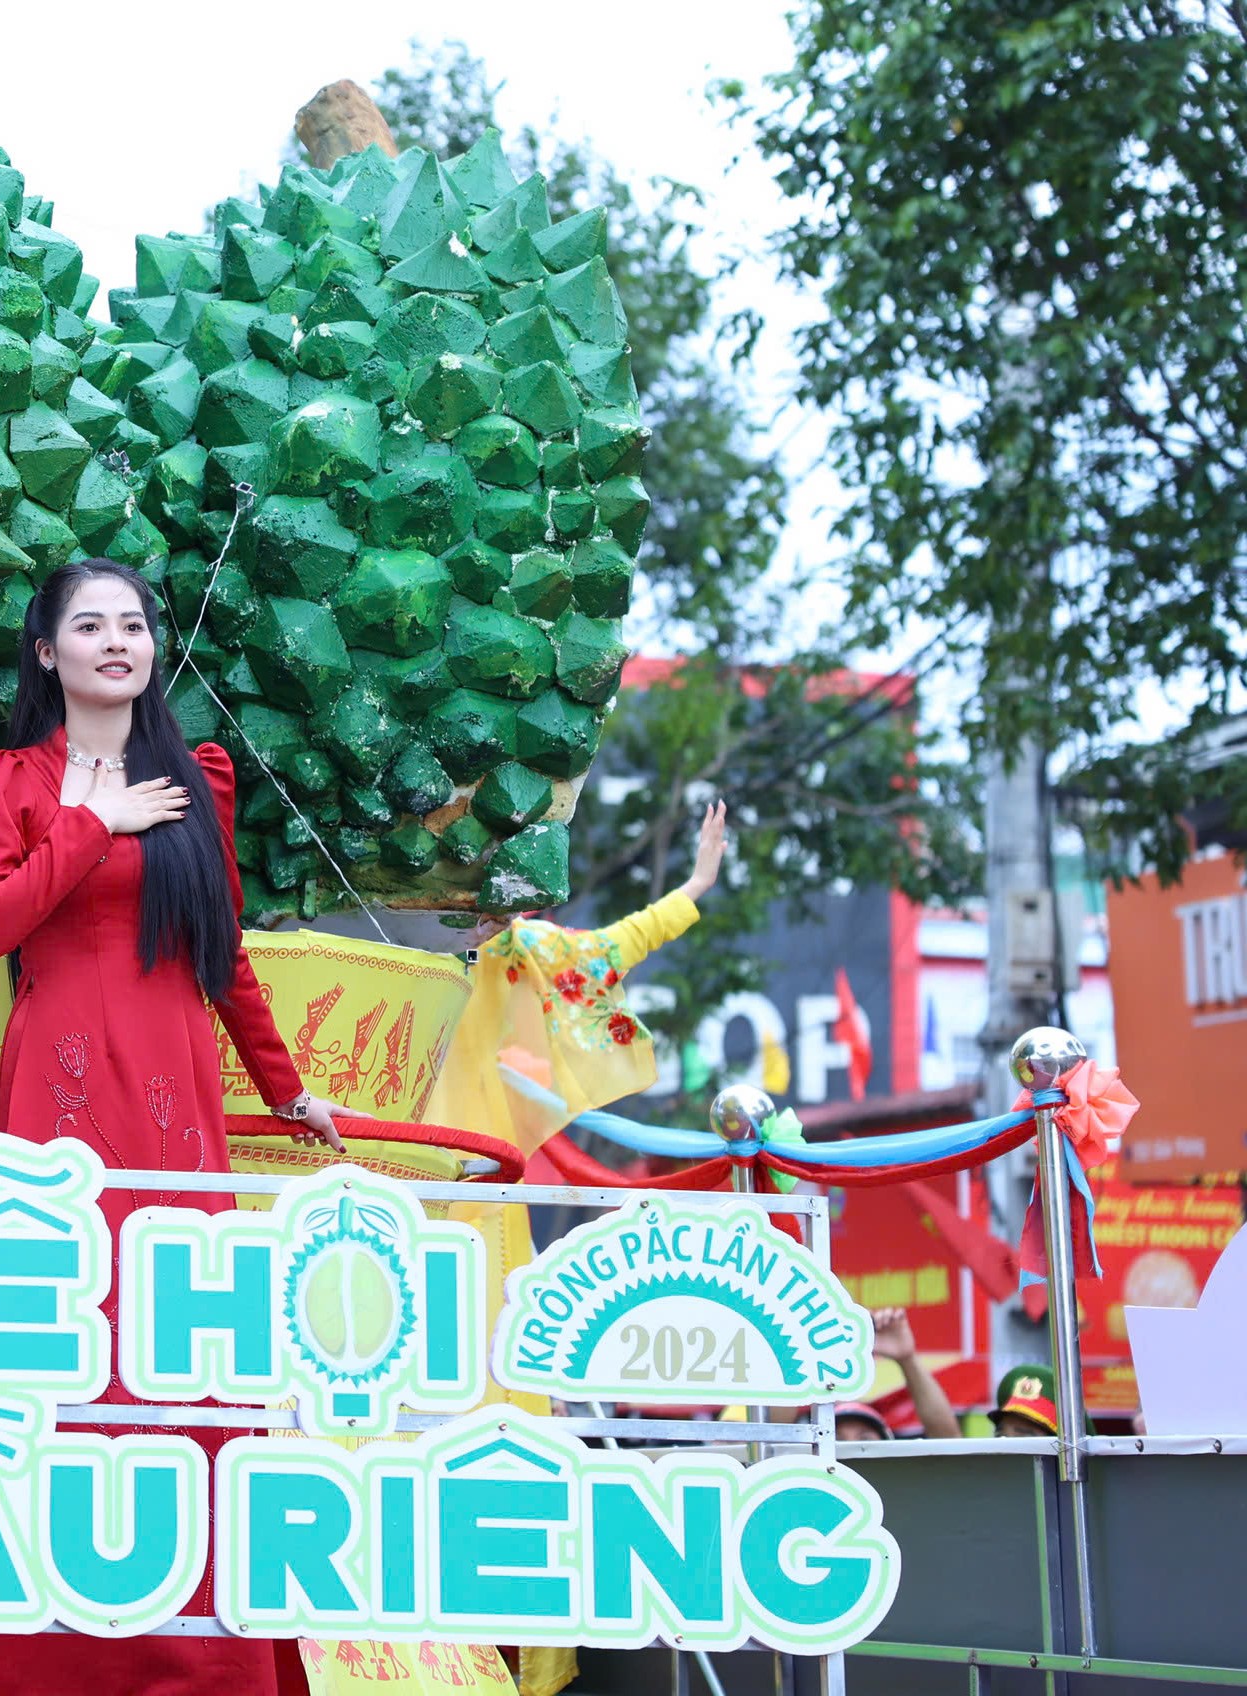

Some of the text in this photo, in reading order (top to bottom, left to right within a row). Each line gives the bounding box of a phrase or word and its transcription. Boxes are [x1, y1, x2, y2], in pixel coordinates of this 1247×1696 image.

[152, 1197, 458, 1418] HỘI
[517, 1244, 618, 1372] KRÔNG
[619, 1212, 692, 1270] PẮC
[702, 1222, 779, 1286] LẦN
[777, 1265, 854, 1351] THỨ
[816, 1358, 853, 1383] 2
[620, 1325, 750, 1383] 2024
[248, 1437, 871, 1625] RIÊNG
